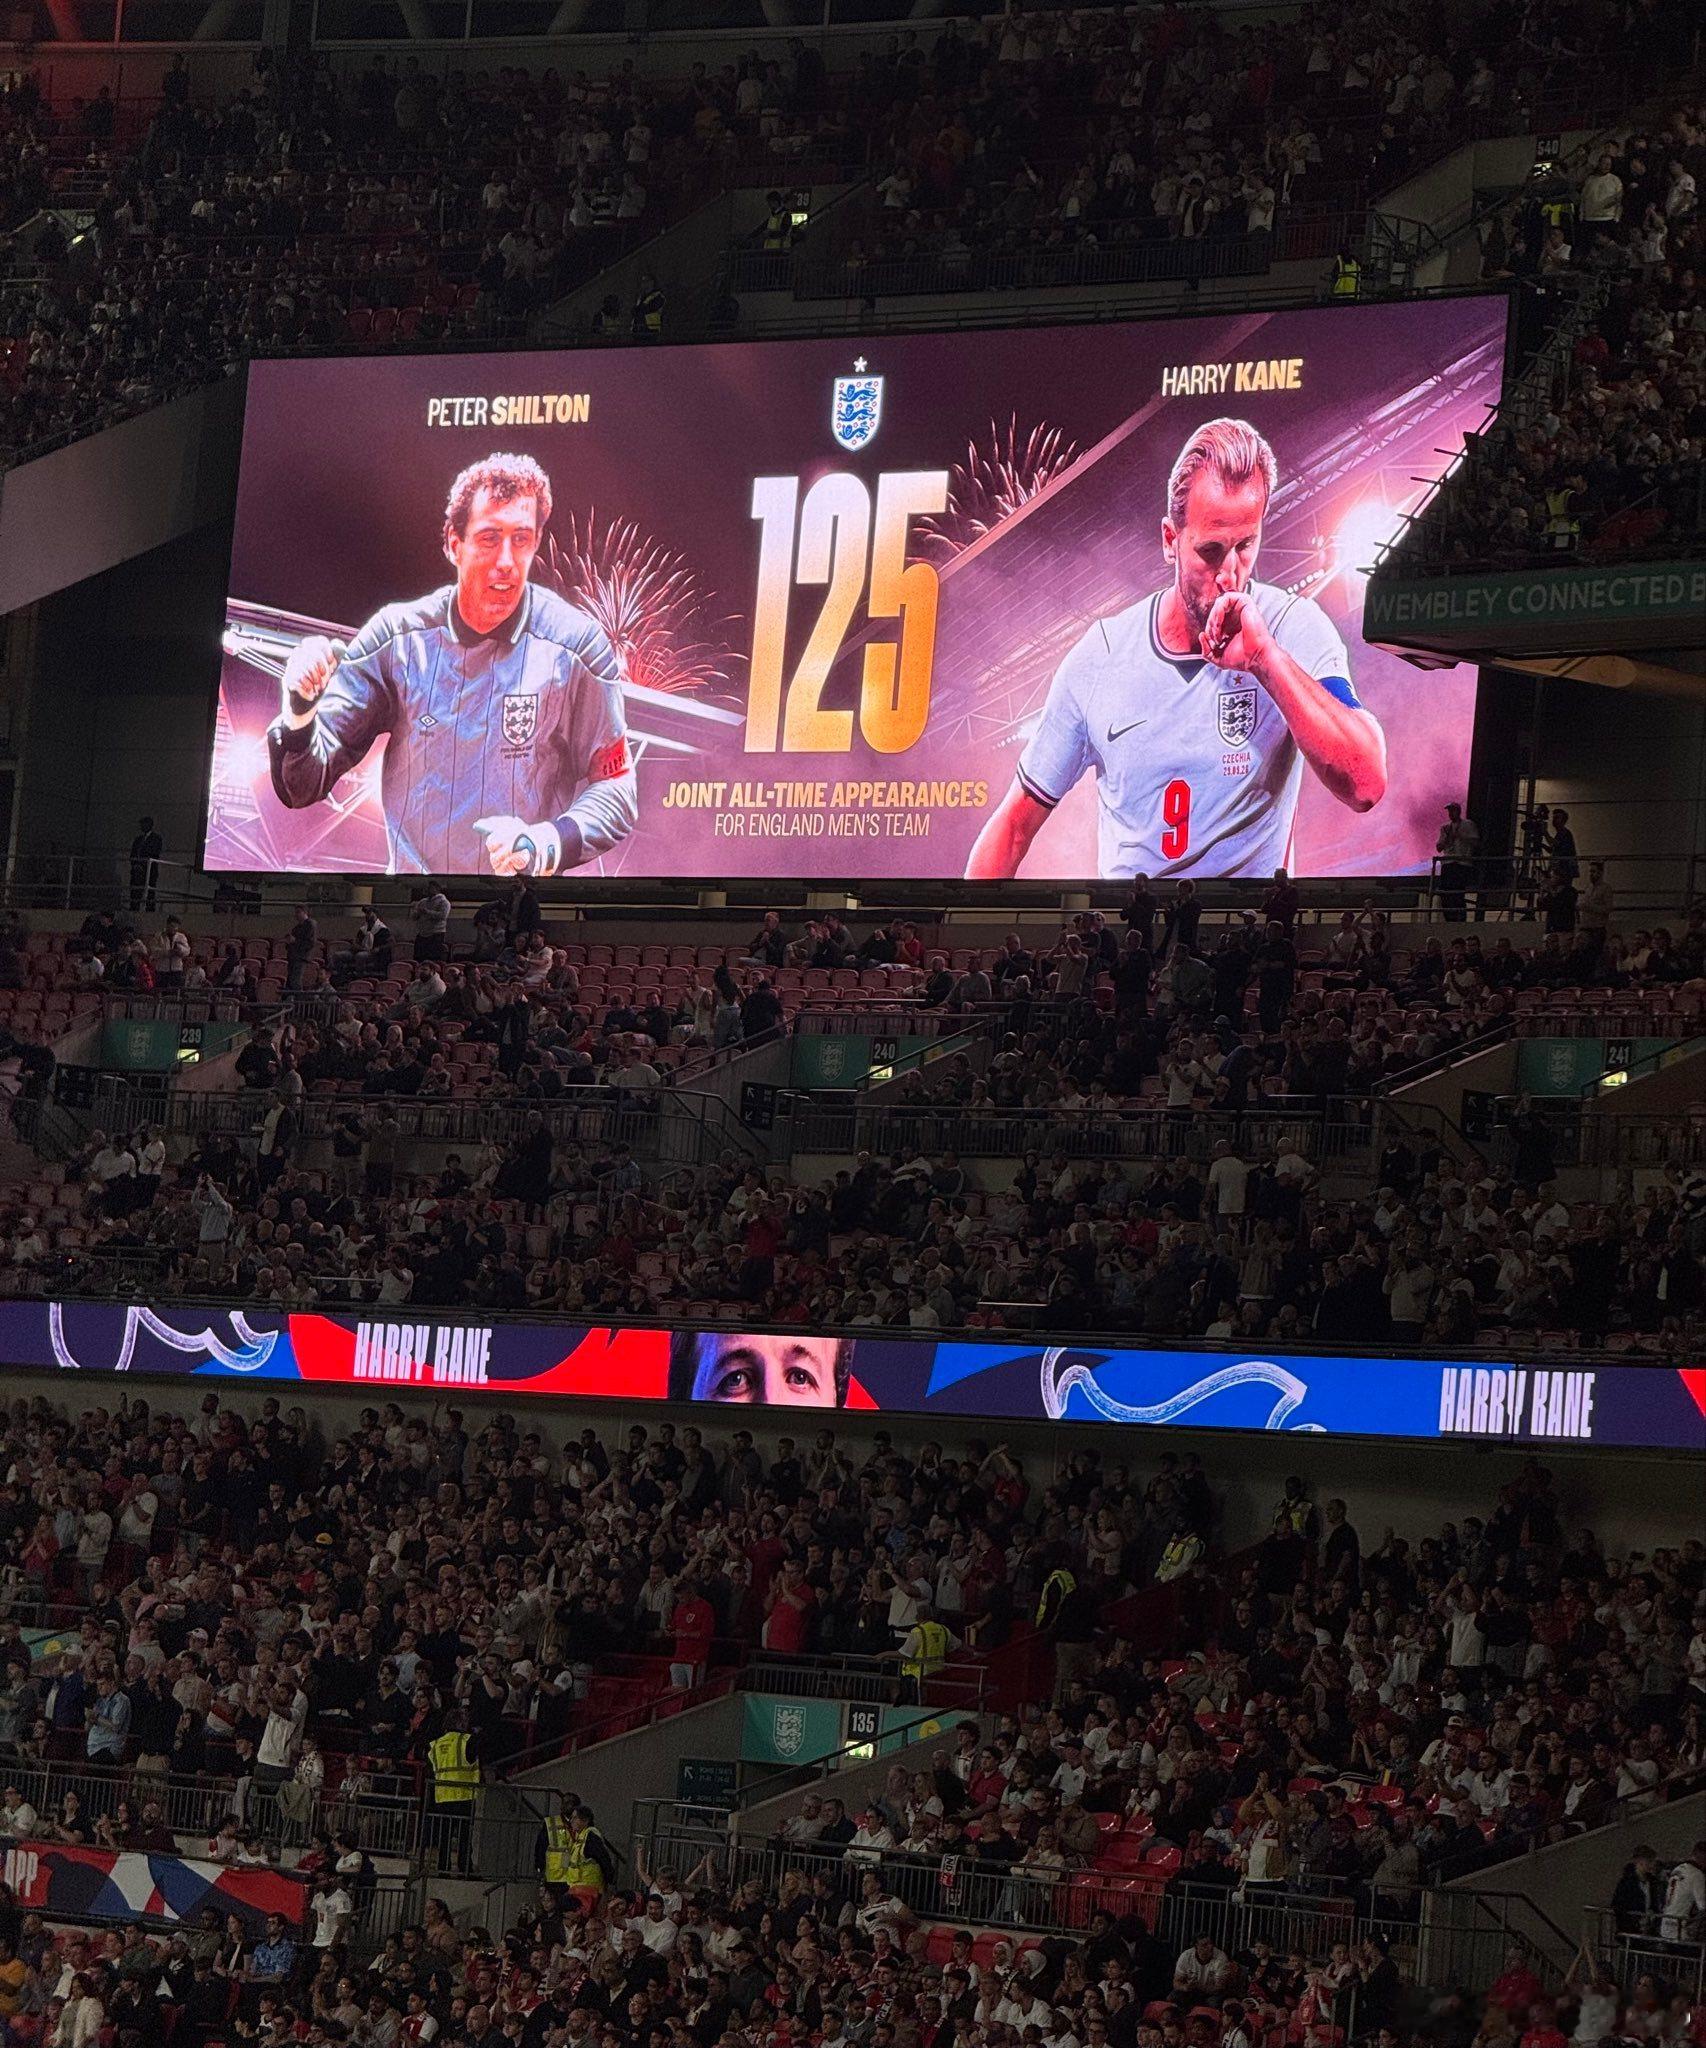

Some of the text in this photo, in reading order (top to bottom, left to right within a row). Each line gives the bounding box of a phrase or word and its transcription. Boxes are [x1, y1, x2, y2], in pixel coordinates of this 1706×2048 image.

[1162, 359, 1303, 396] HARRY KANE
[427, 394, 590, 427] PETER SHILTON
[744, 471, 949, 753] 125
[1372, 587, 1501, 622] WEMBLEY
[1508, 575, 1685, 614] CONNECTED
[1222, 752, 1251, 764] CZECHIA
[663, 781, 989, 808] JOINT ALL-TIME APPEARANCES
[714, 813, 930, 837] FOR ENGLAND MEN'S TEAM
[1162, 780, 1190, 859] 9
[181, 1028, 202, 1043] 239
[873, 1042, 896, 1059] 240
[1608, 1046, 1630, 1065] 241
[353, 1322, 492, 1384] HARRY KANE
[1439, 1368, 1595, 1437] HARRY KANE
[852, 1712, 875, 1733] 135
